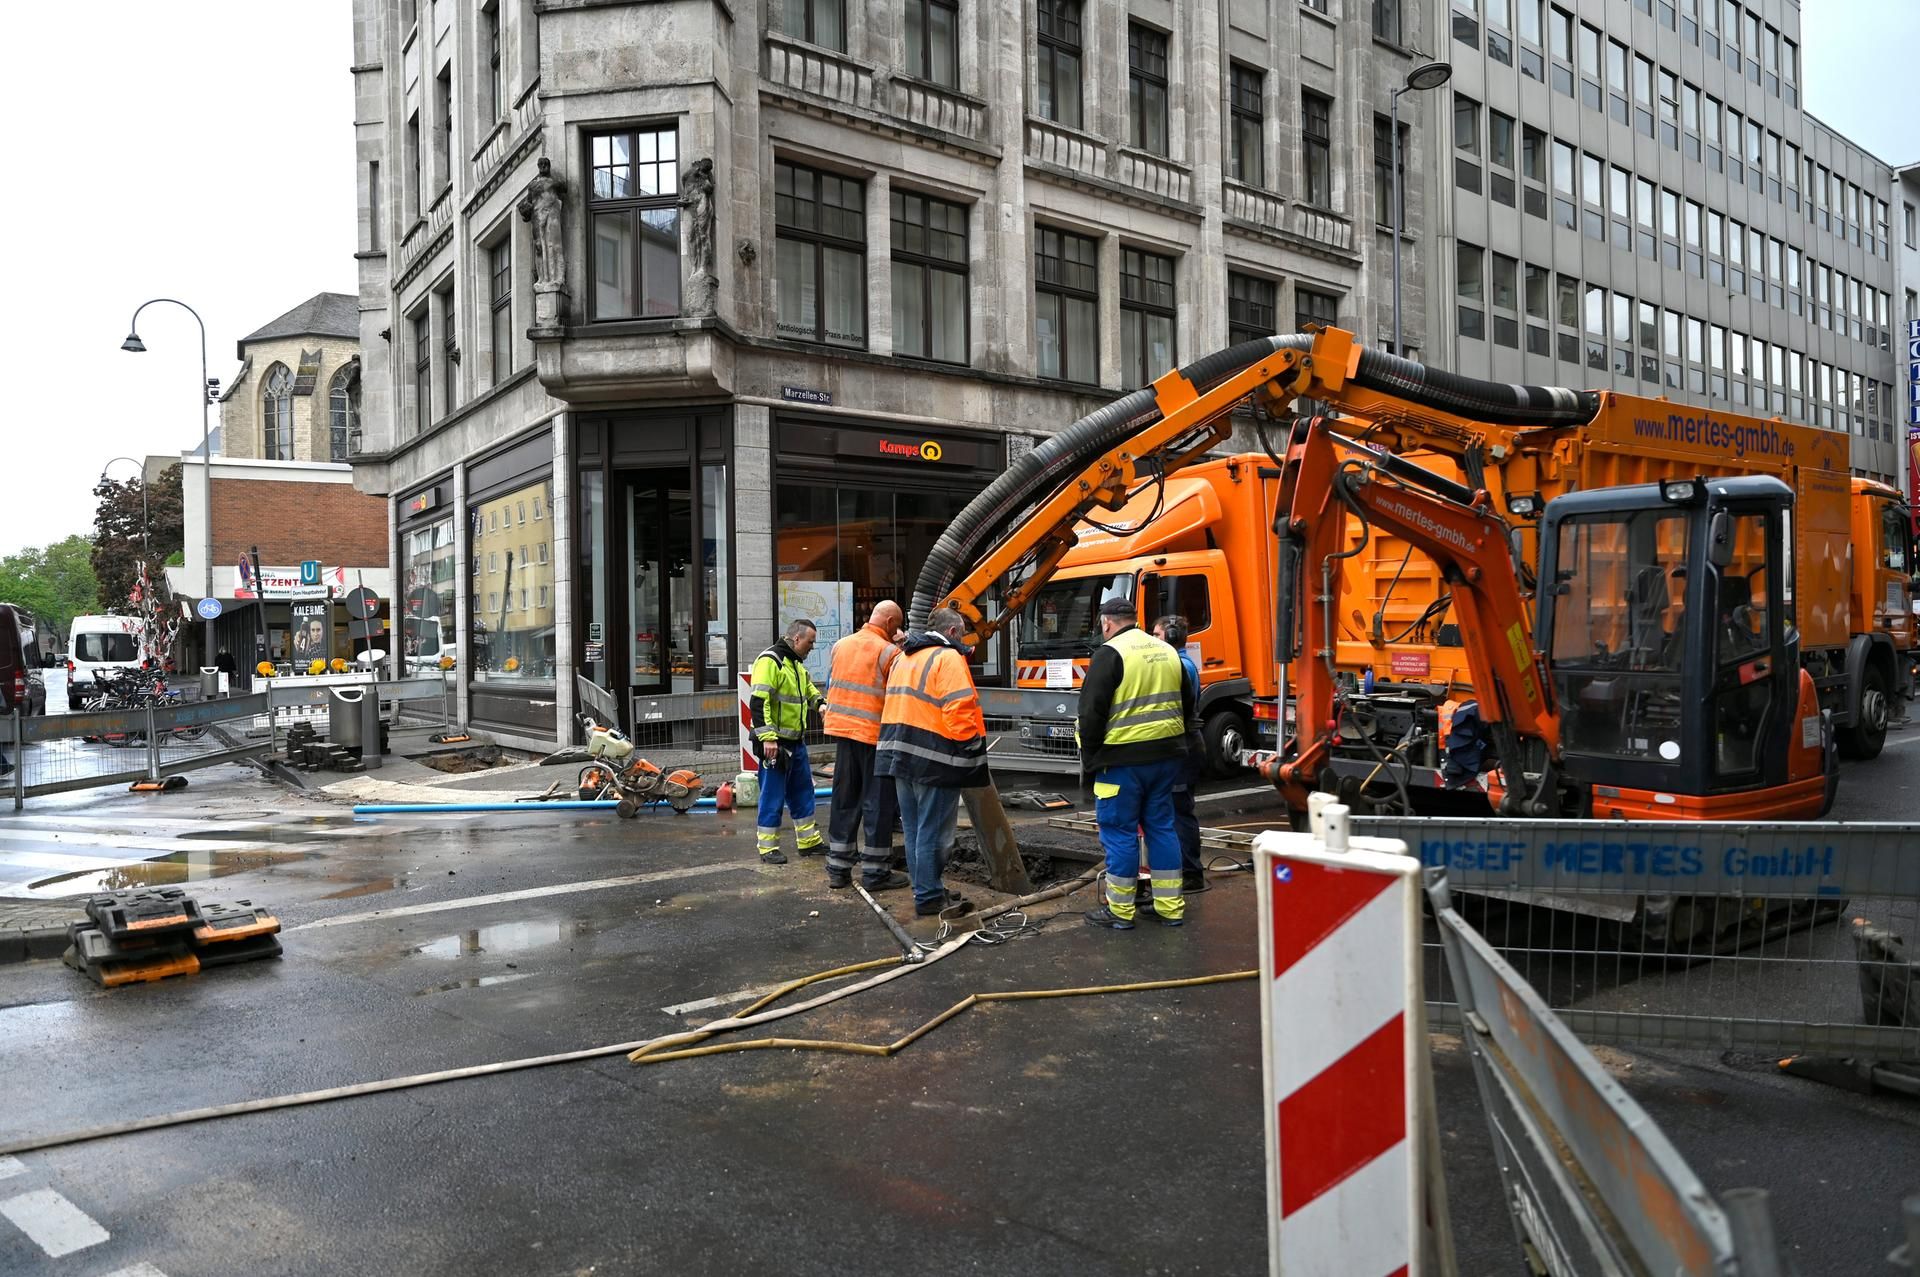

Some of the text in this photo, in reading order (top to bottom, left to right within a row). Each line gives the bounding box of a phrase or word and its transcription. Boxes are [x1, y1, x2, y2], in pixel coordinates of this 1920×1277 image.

[879, 439, 919, 457] Kamps
[1634, 412, 1795, 457] www.mertes-gmbh.de
[1375, 496, 1477, 553] www.mertes-gmbh.de
[304, 563, 314, 581] U
[1544, 841, 1704, 875] MERTES
[1724, 846, 1833, 876] GmbH
